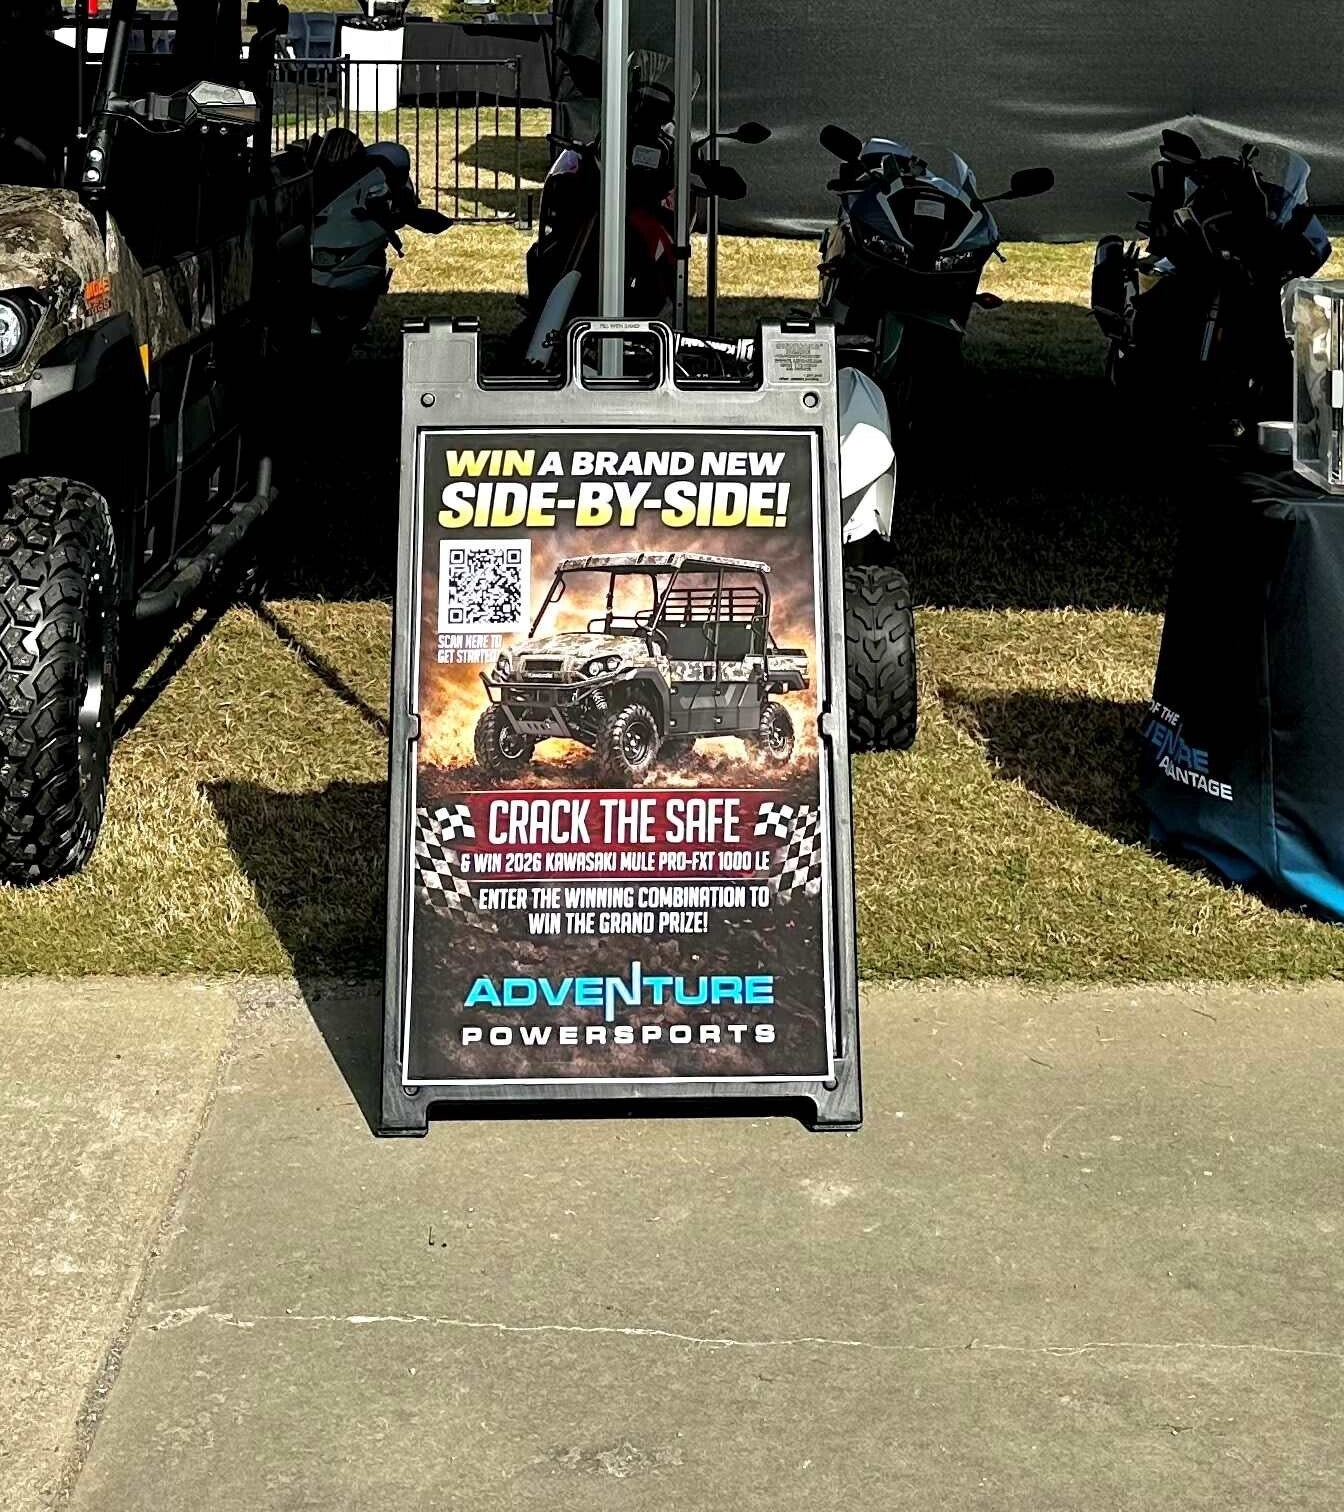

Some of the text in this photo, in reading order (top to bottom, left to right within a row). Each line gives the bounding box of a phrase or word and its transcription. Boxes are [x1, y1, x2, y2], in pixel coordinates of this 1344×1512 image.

[445, 449, 786, 477] WIN A BRAND NEW
[437, 481, 790, 529] SIDE-BY-SIDE!
[1160, 706, 1180, 726] THE
[488, 798, 740, 845] CRACK THE SAFE
[460, 851, 770, 874] & WIN 2026 KAWASAKI MULE PRO-FXT 1000 LE
[479, 887, 770, 910] ENTER THE WINNING COMBINATION TO
[529, 912, 708, 935] WIN THE GRAND PRIZE!
[463, 961, 774, 1022] ADVENTURE
[461, 1024, 776, 1046] POWERSPORTS
